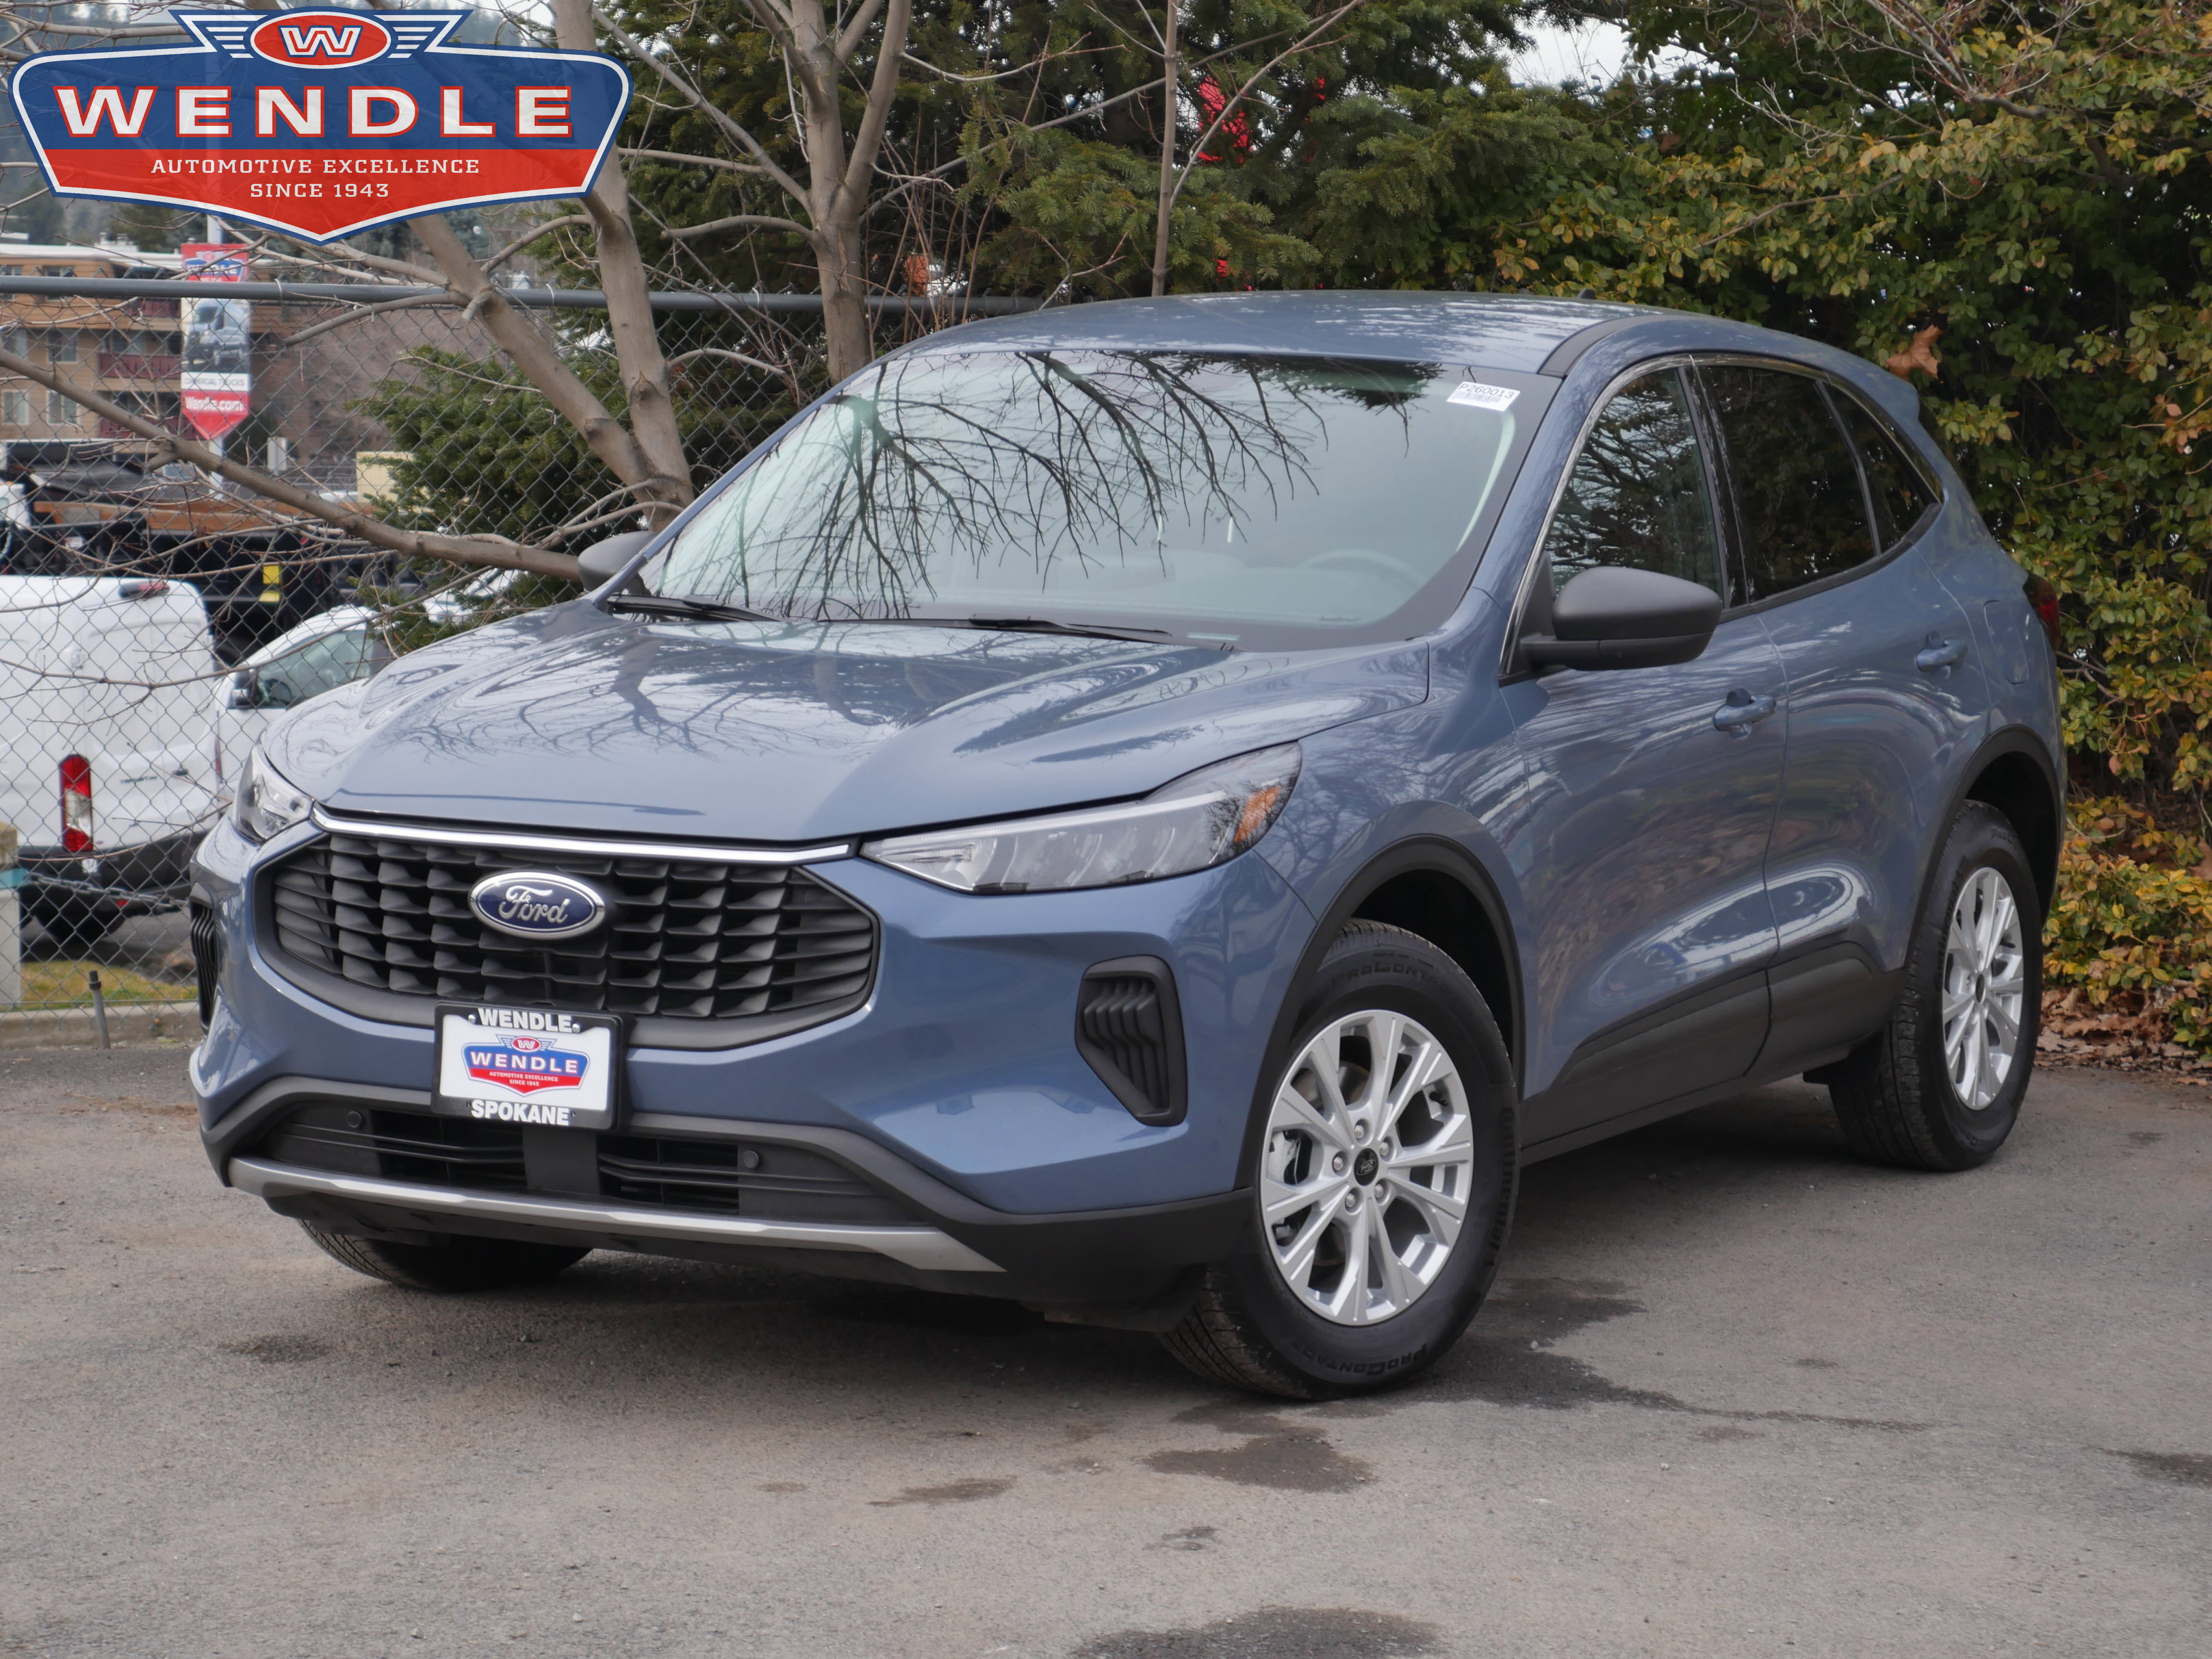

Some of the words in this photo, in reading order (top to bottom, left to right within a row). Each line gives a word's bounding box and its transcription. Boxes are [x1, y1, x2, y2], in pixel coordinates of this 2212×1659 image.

[1458, 383, 1515, 398] P260013
[499, 885, 569, 925] Ford
[478, 1008, 572, 1033] WENDLE
[470, 1051, 578, 1074] WENDLE
[489, 1071, 524, 1079] AUTOMOTIVE
[471, 1099, 569, 1126] SPOKANE
